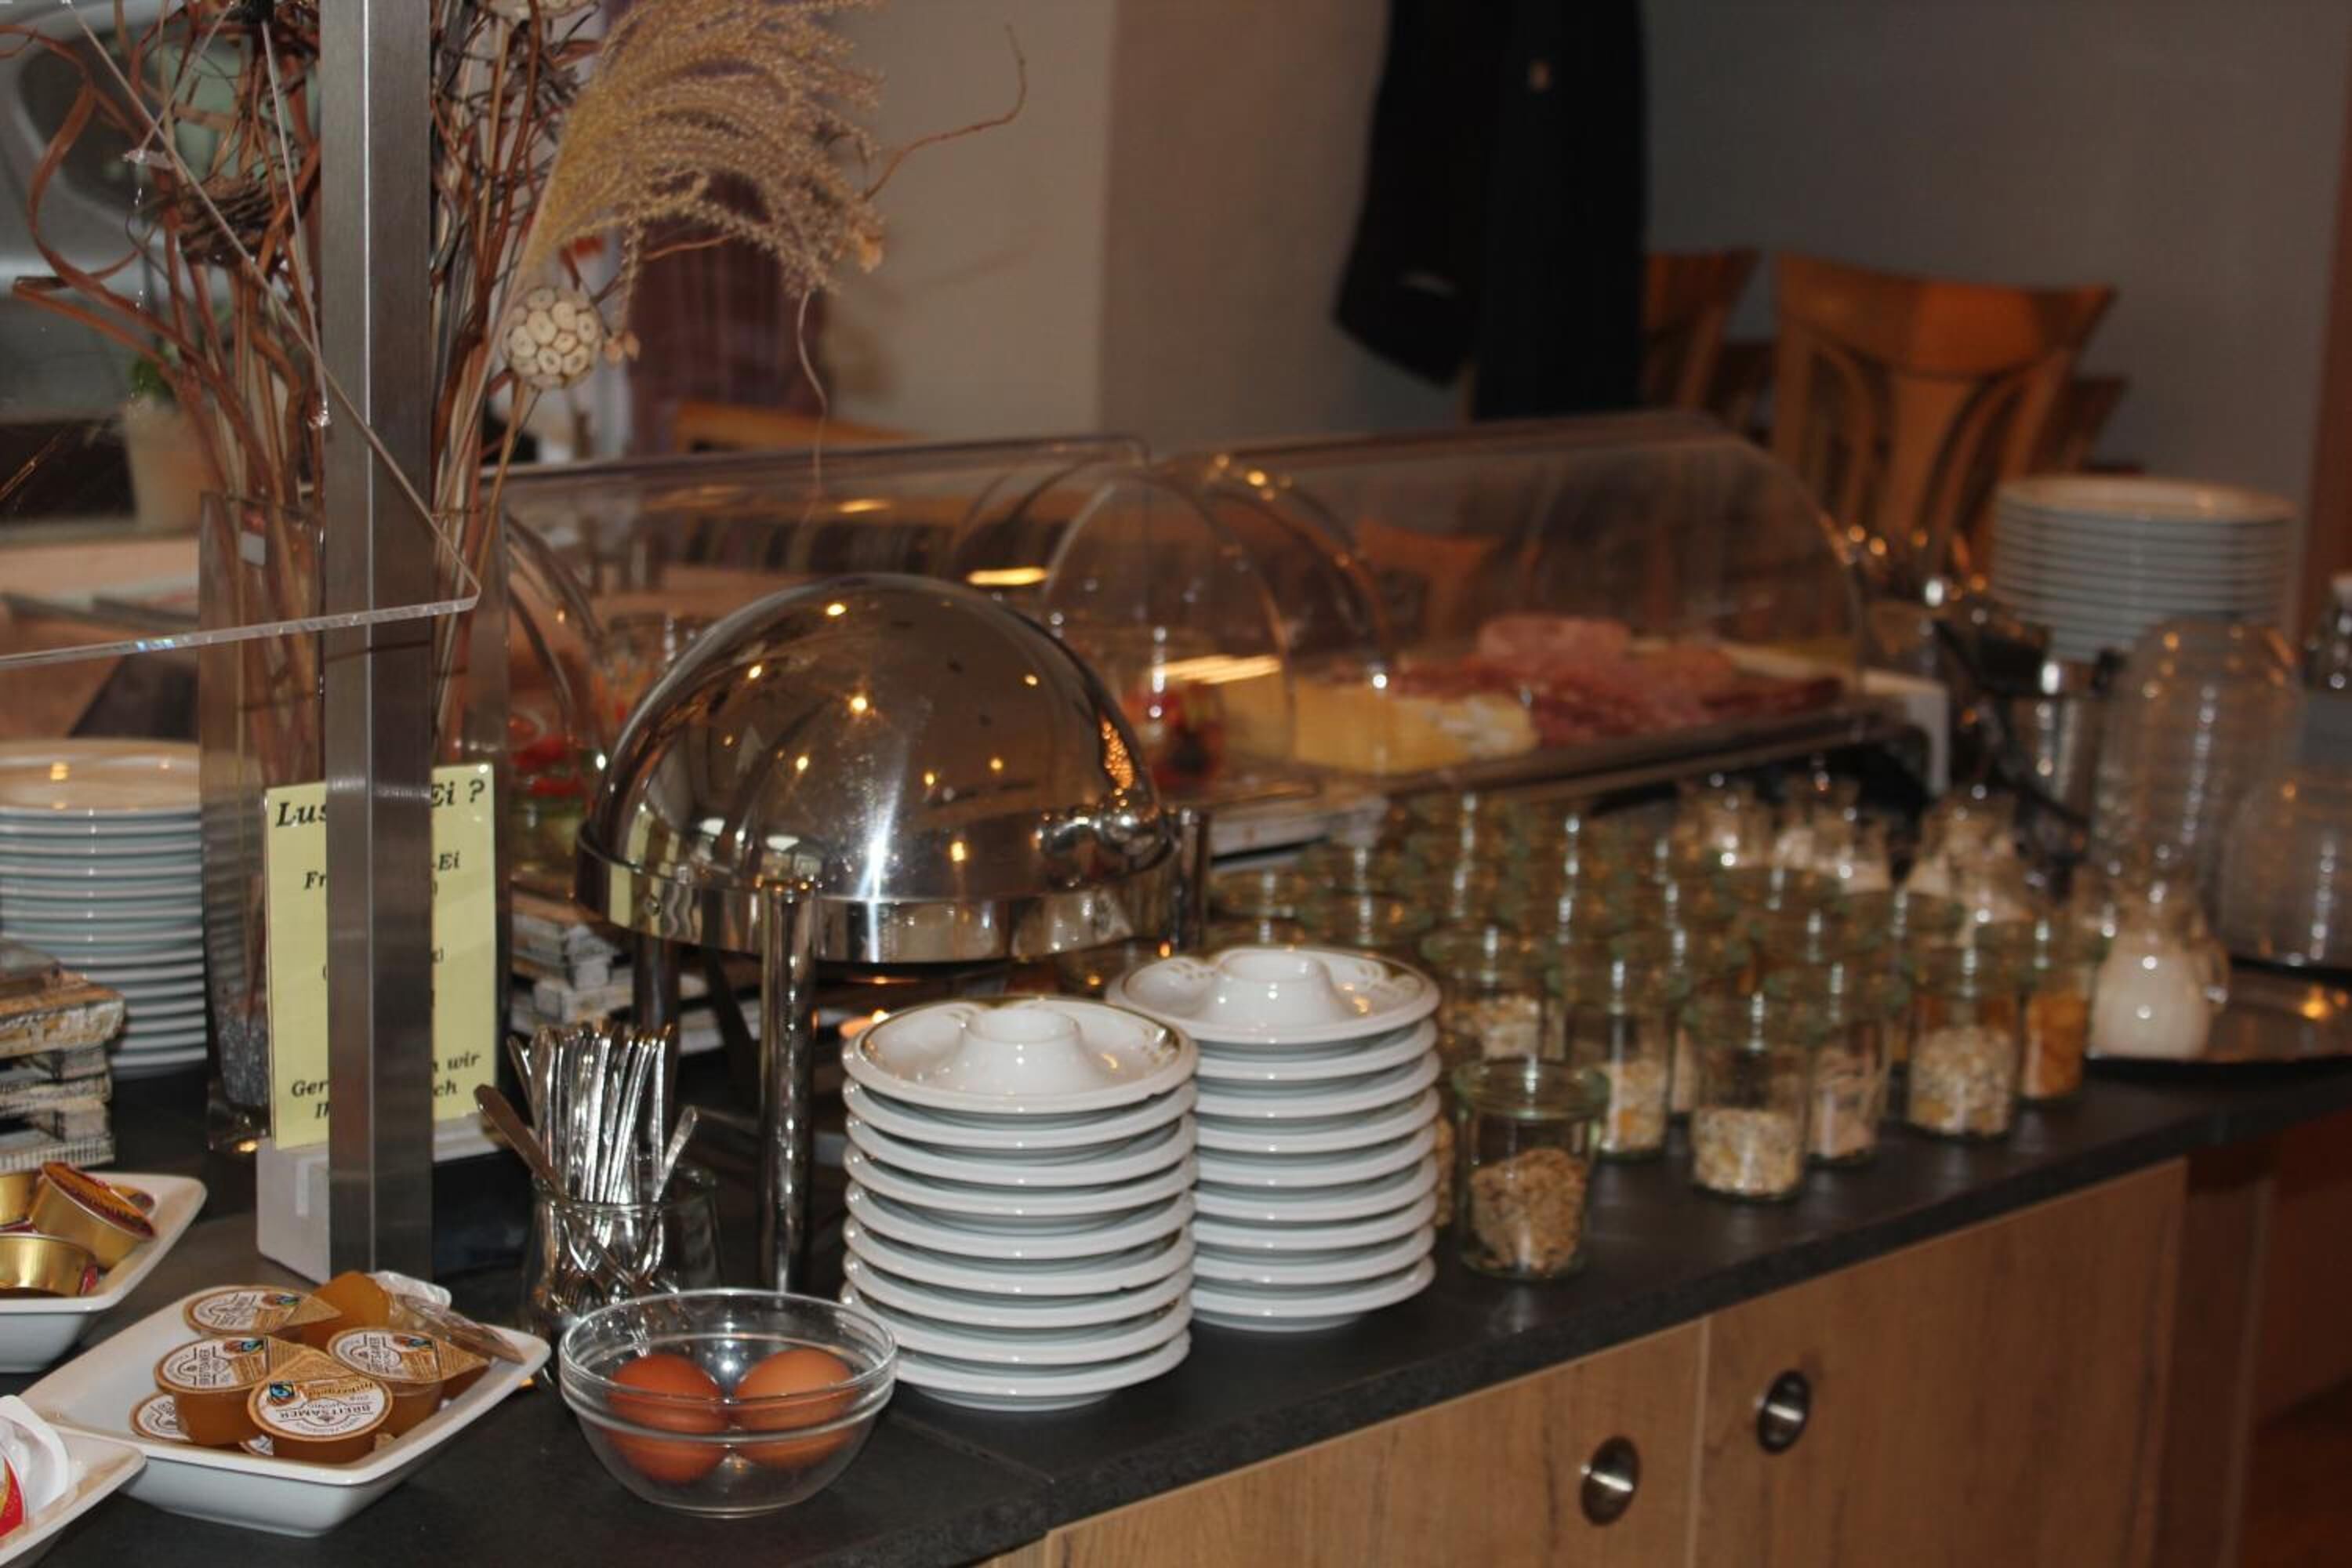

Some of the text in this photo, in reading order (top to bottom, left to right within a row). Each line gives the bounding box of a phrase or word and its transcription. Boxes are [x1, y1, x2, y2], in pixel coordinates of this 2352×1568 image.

[432, 781, 455, 806] Ei
[469, 779, 485, 804] ?
[447, 1051, 481, 1071] wir
